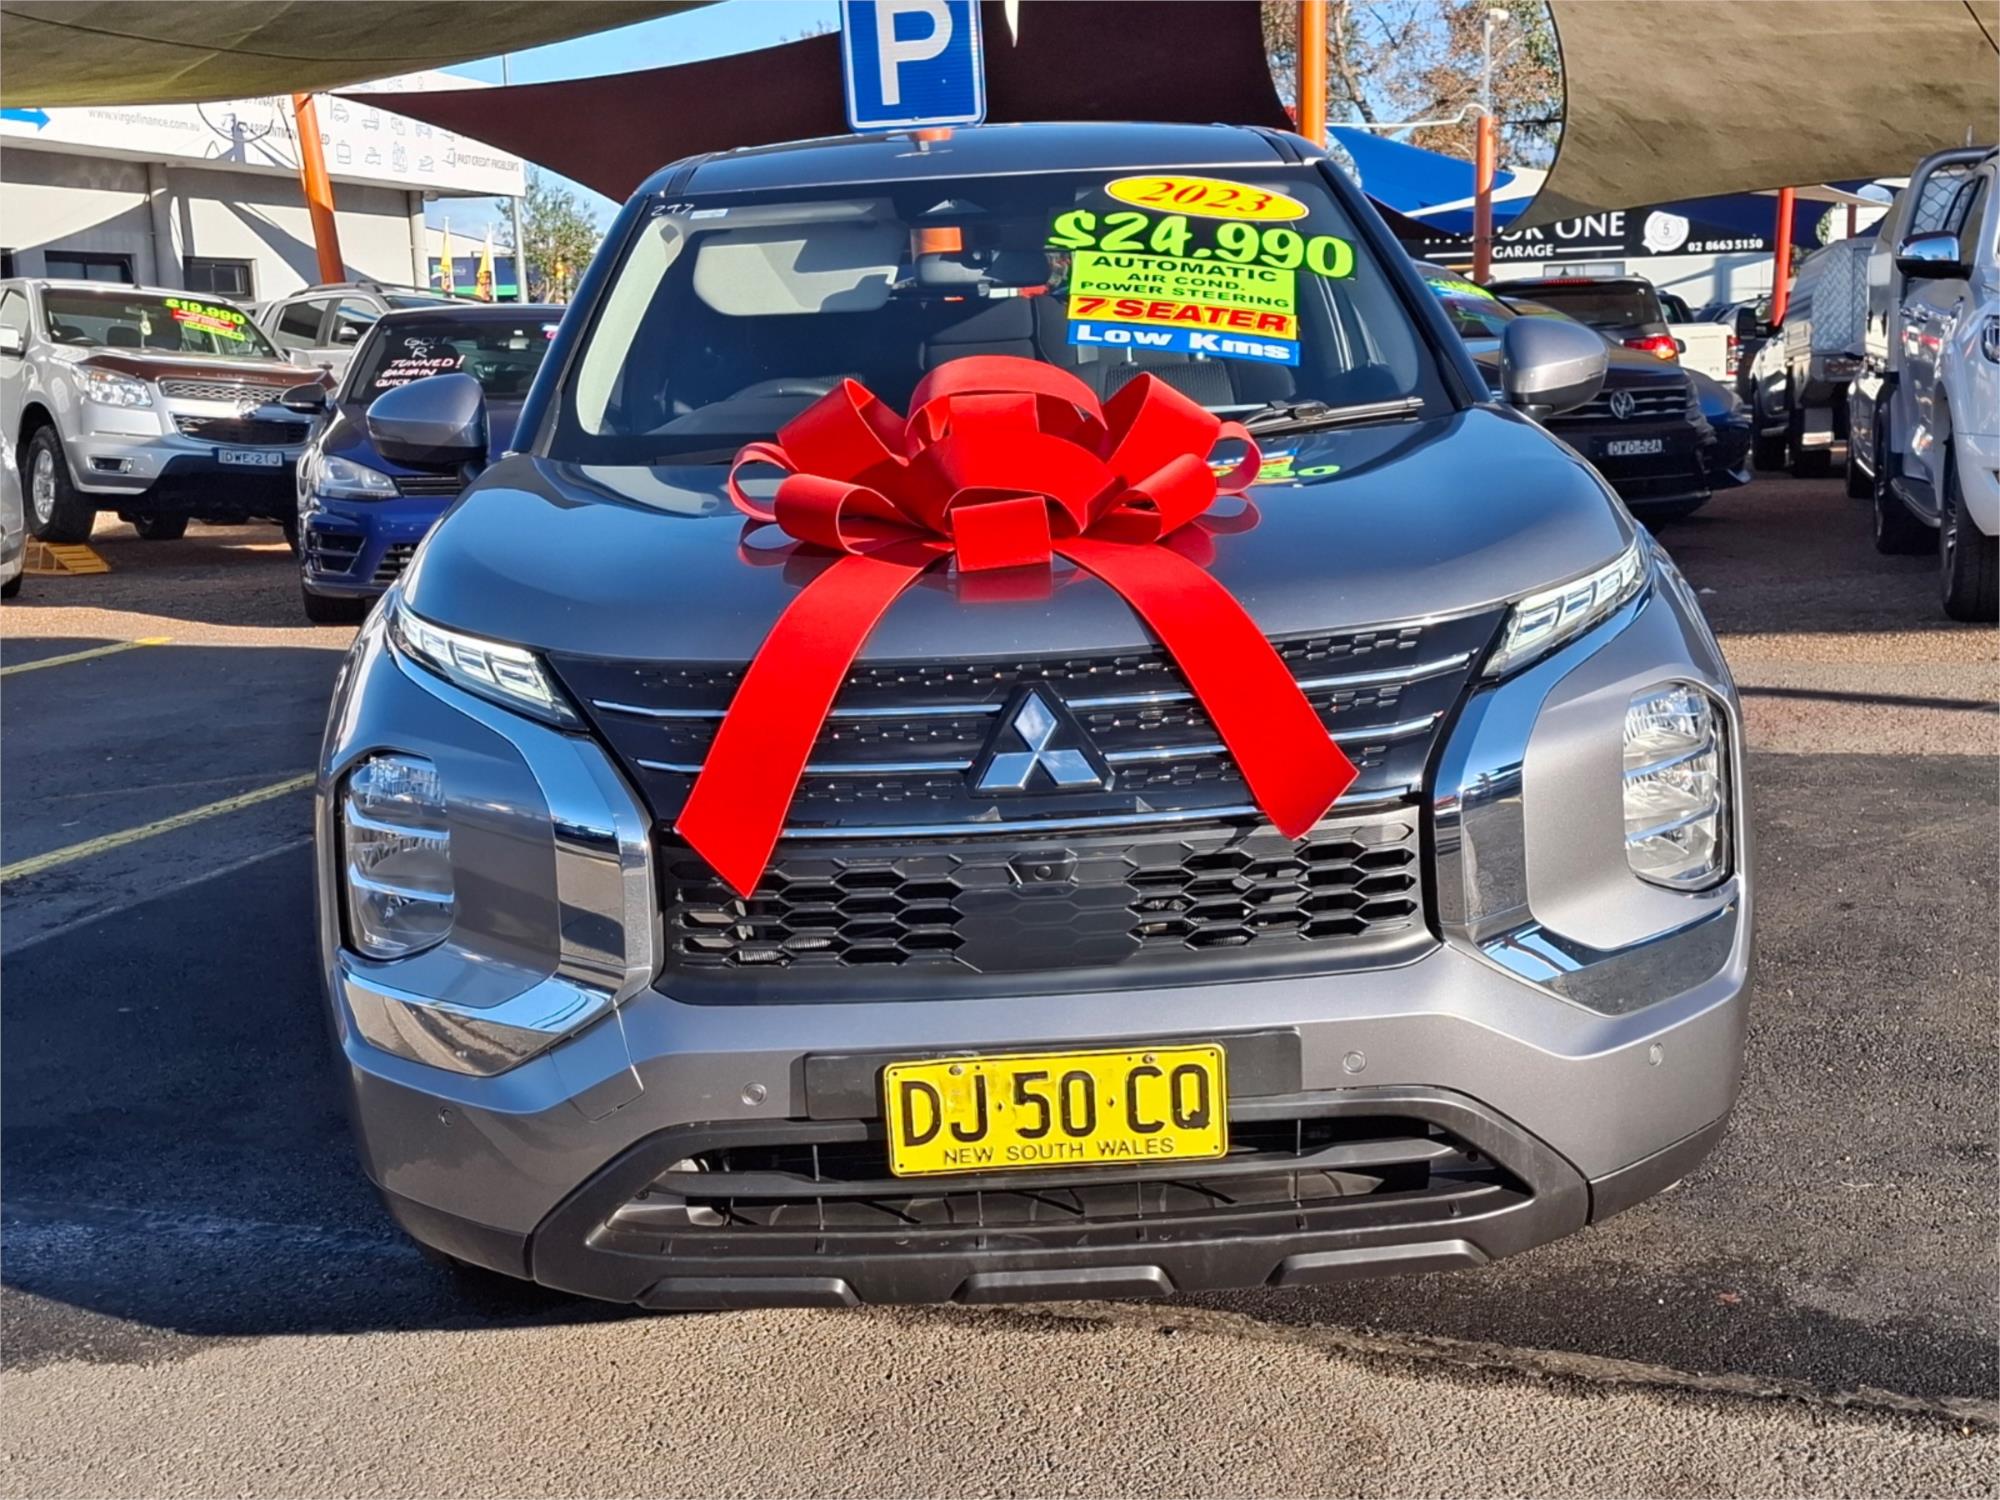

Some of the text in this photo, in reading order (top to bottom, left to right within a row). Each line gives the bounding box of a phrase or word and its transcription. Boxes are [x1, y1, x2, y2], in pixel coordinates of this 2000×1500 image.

[875, 0, 953, 106] P
[1139, 181, 1273, 213] 2023
[1555, 211, 1626, 239] ONE
[1491, 244, 1554, 259] GARAGE
[1687, 241, 1703, 252] 02
[1091, 256, 1277, 282] AUTOMATIC
[1127, 273, 1246, 291] AIR COND.
[1080, 281, 1289, 308] POWER STEERING
[1076, 296, 1289, 332] 7 SEATER
[1076, 324, 1291, 360] Low Kms
[943, 1137, 1175, 1166] NEW SOUTH WALES
